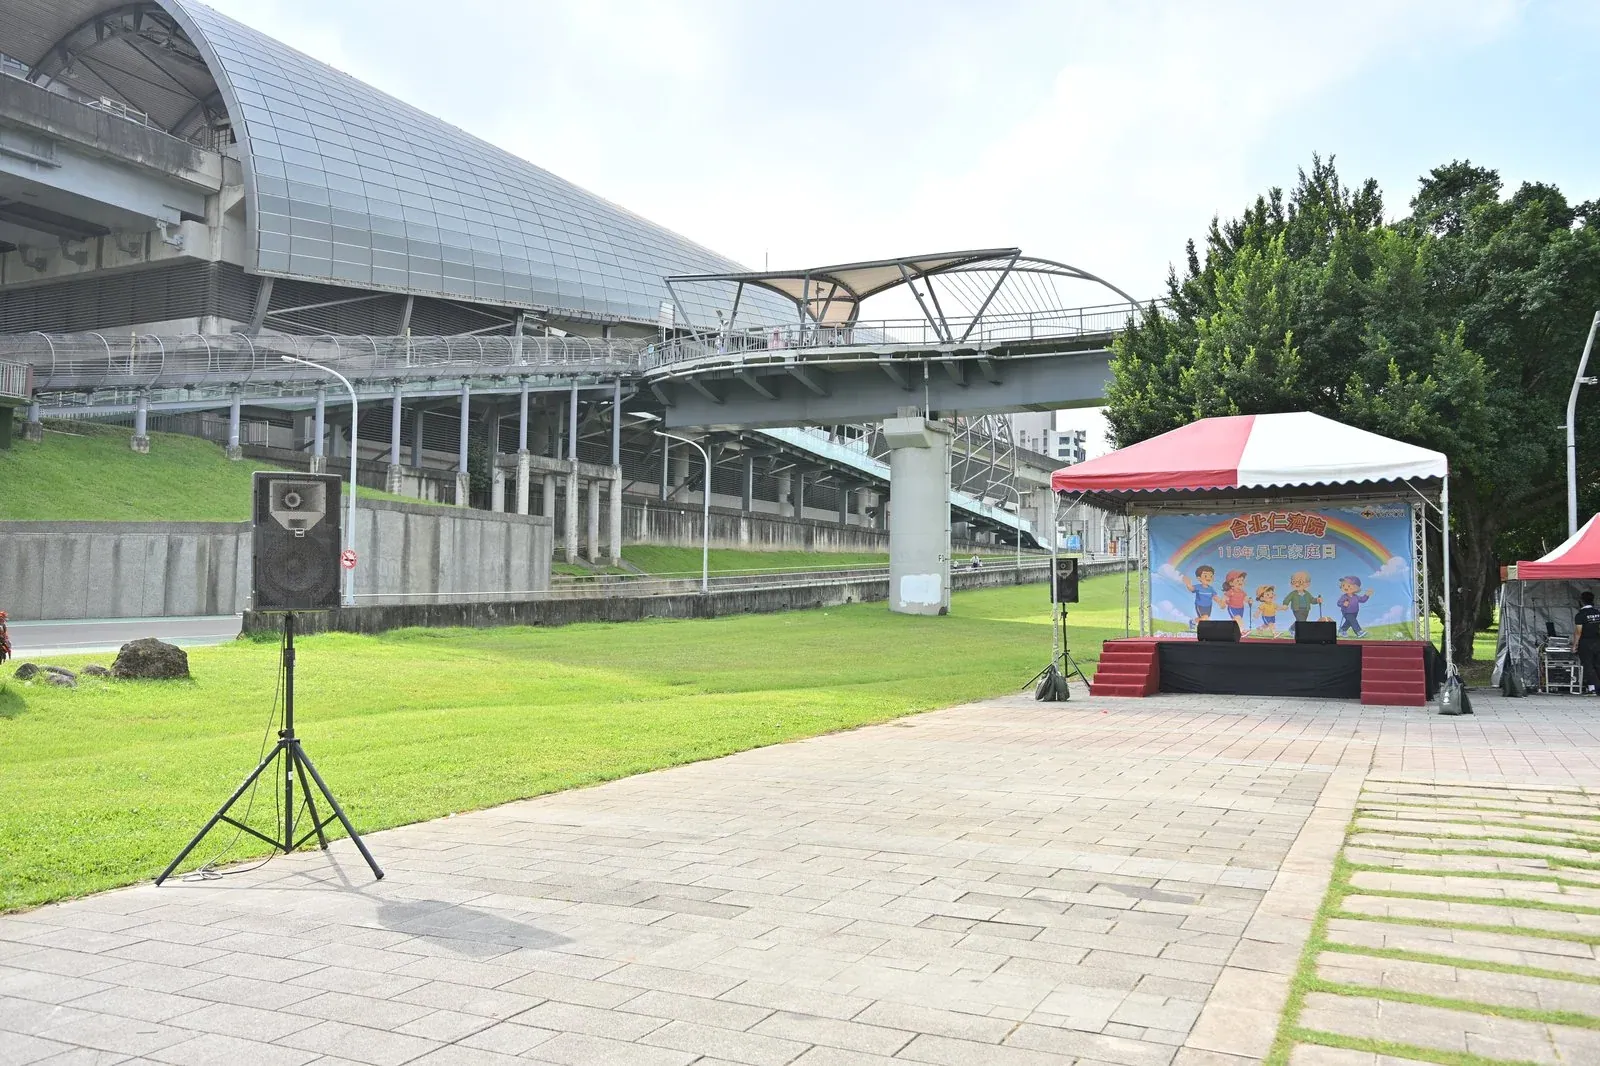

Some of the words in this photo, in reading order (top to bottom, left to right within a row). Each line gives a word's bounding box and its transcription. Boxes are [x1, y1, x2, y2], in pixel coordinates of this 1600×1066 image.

[1230, 511, 1327, 539] 台北仁濟院
